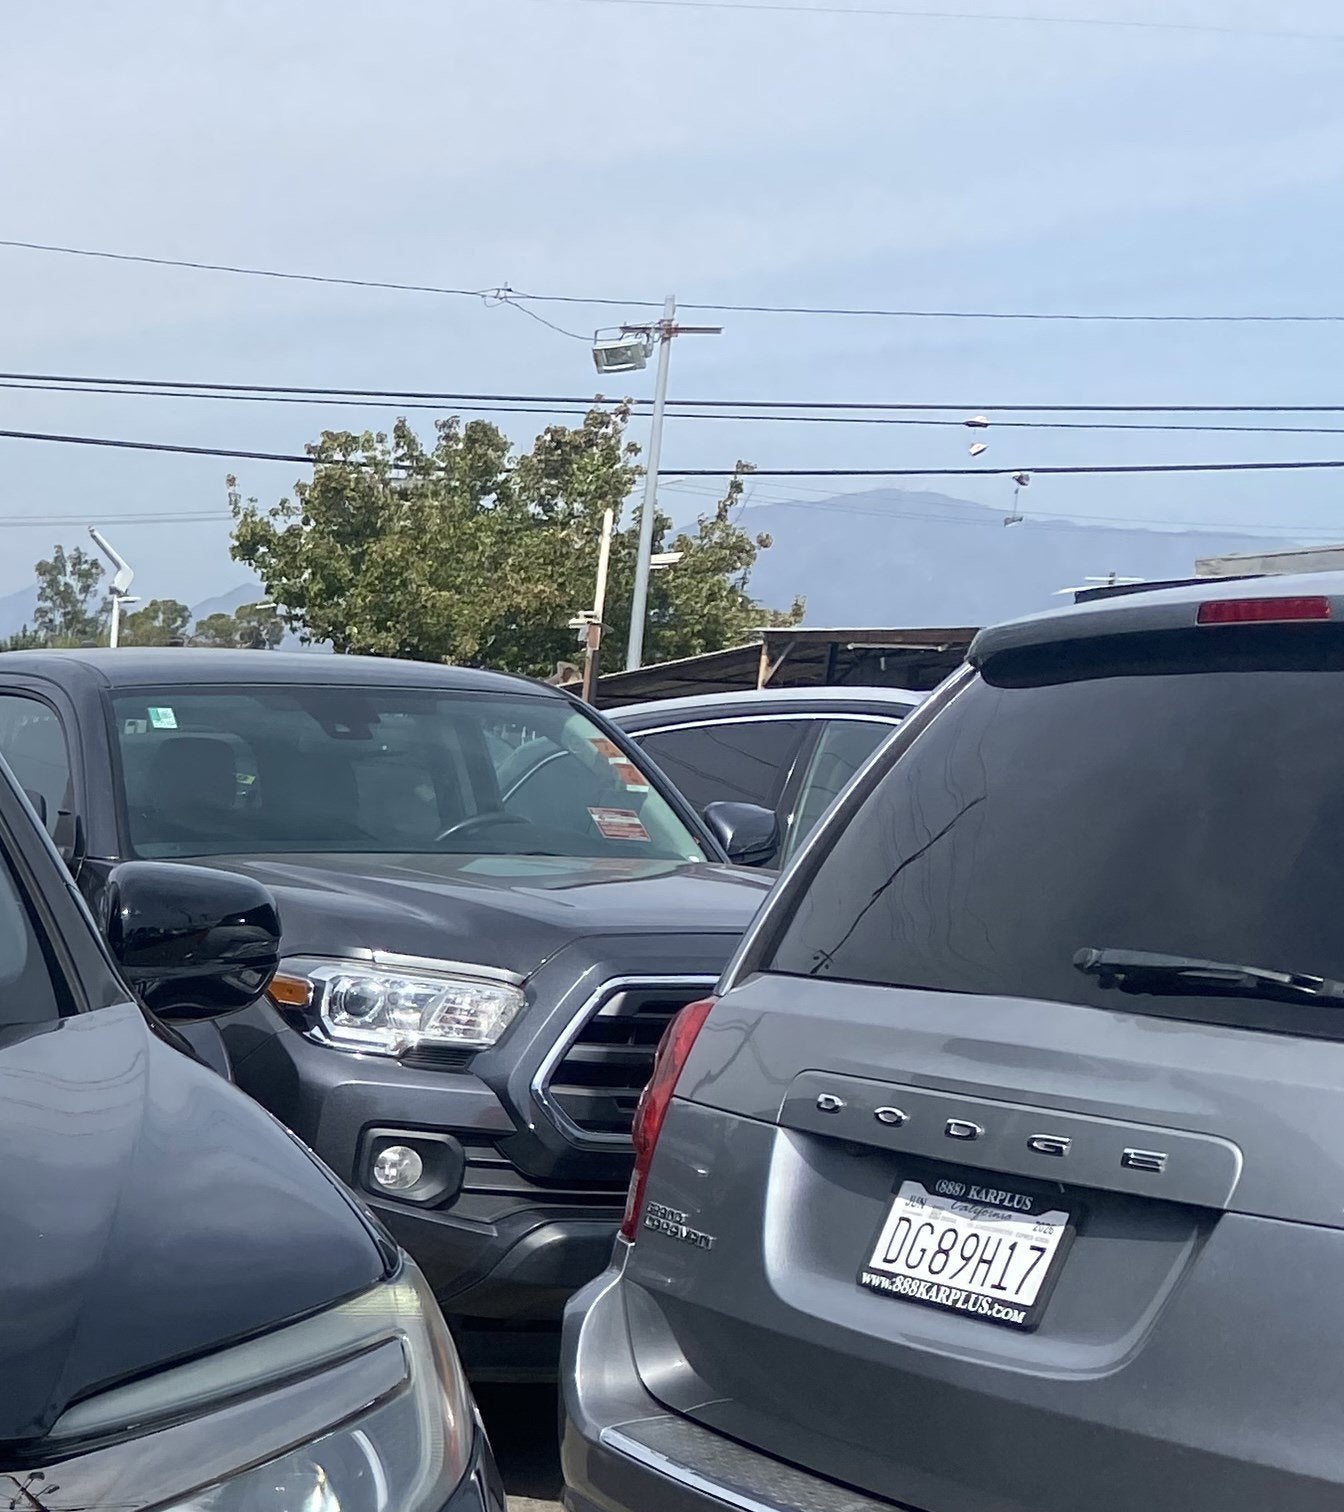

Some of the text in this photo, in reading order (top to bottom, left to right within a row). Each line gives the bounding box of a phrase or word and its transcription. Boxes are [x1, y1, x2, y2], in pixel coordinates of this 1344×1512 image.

[817, 1093, 1168, 1173] DODGE
[935, 1178, 1034, 1211] (888) KARPLUS
[882, 1216, 1047, 1295] DG89H17
